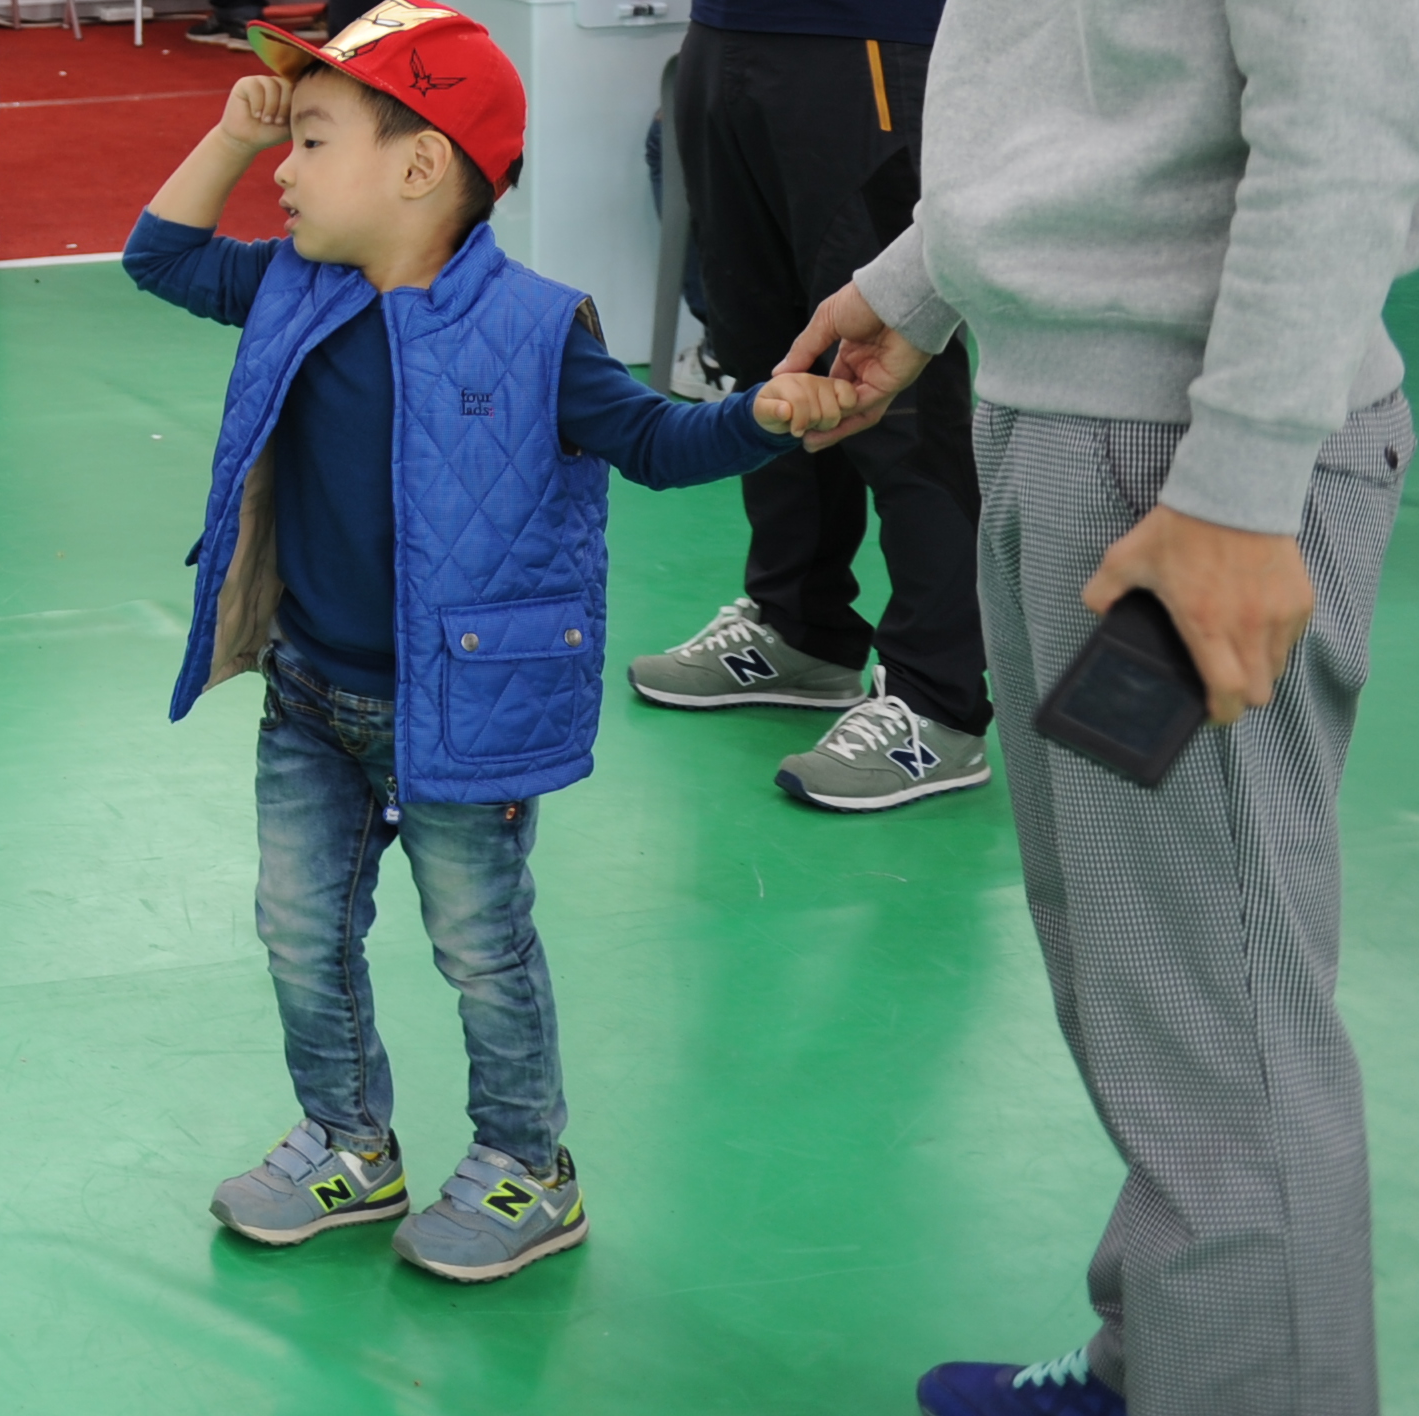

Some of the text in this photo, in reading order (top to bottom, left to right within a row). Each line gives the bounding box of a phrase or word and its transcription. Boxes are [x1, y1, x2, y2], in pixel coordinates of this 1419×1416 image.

[460, 387, 493, 403] four
[719, 646, 778, 686] N
[886, 737, 941, 780] N
[310, 1174, 357, 1213] N
[482, 1178, 540, 1222] N
